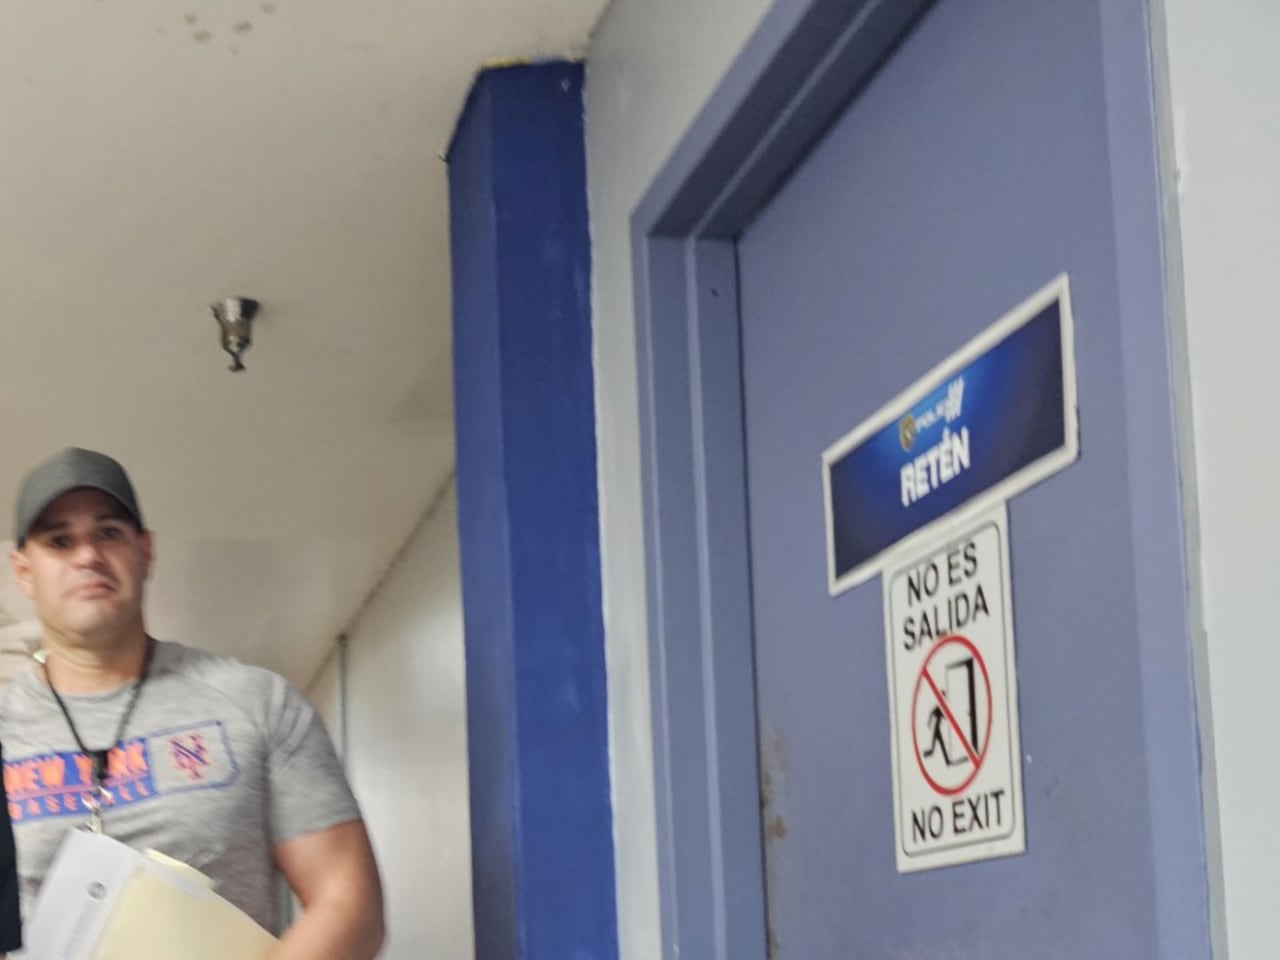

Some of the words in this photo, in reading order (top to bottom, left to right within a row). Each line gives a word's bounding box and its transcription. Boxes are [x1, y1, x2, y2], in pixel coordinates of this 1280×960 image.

[900, 424, 971, 507] RETÉN
[907, 563, 939, 607] NO
[947, 541, 978, 586] ES
[903, 583, 990, 651] SALIDA
[72, 742, 148, 785] YRK
[911, 805, 944, 844] NO
[952, 788, 1005, 835] EXIT
